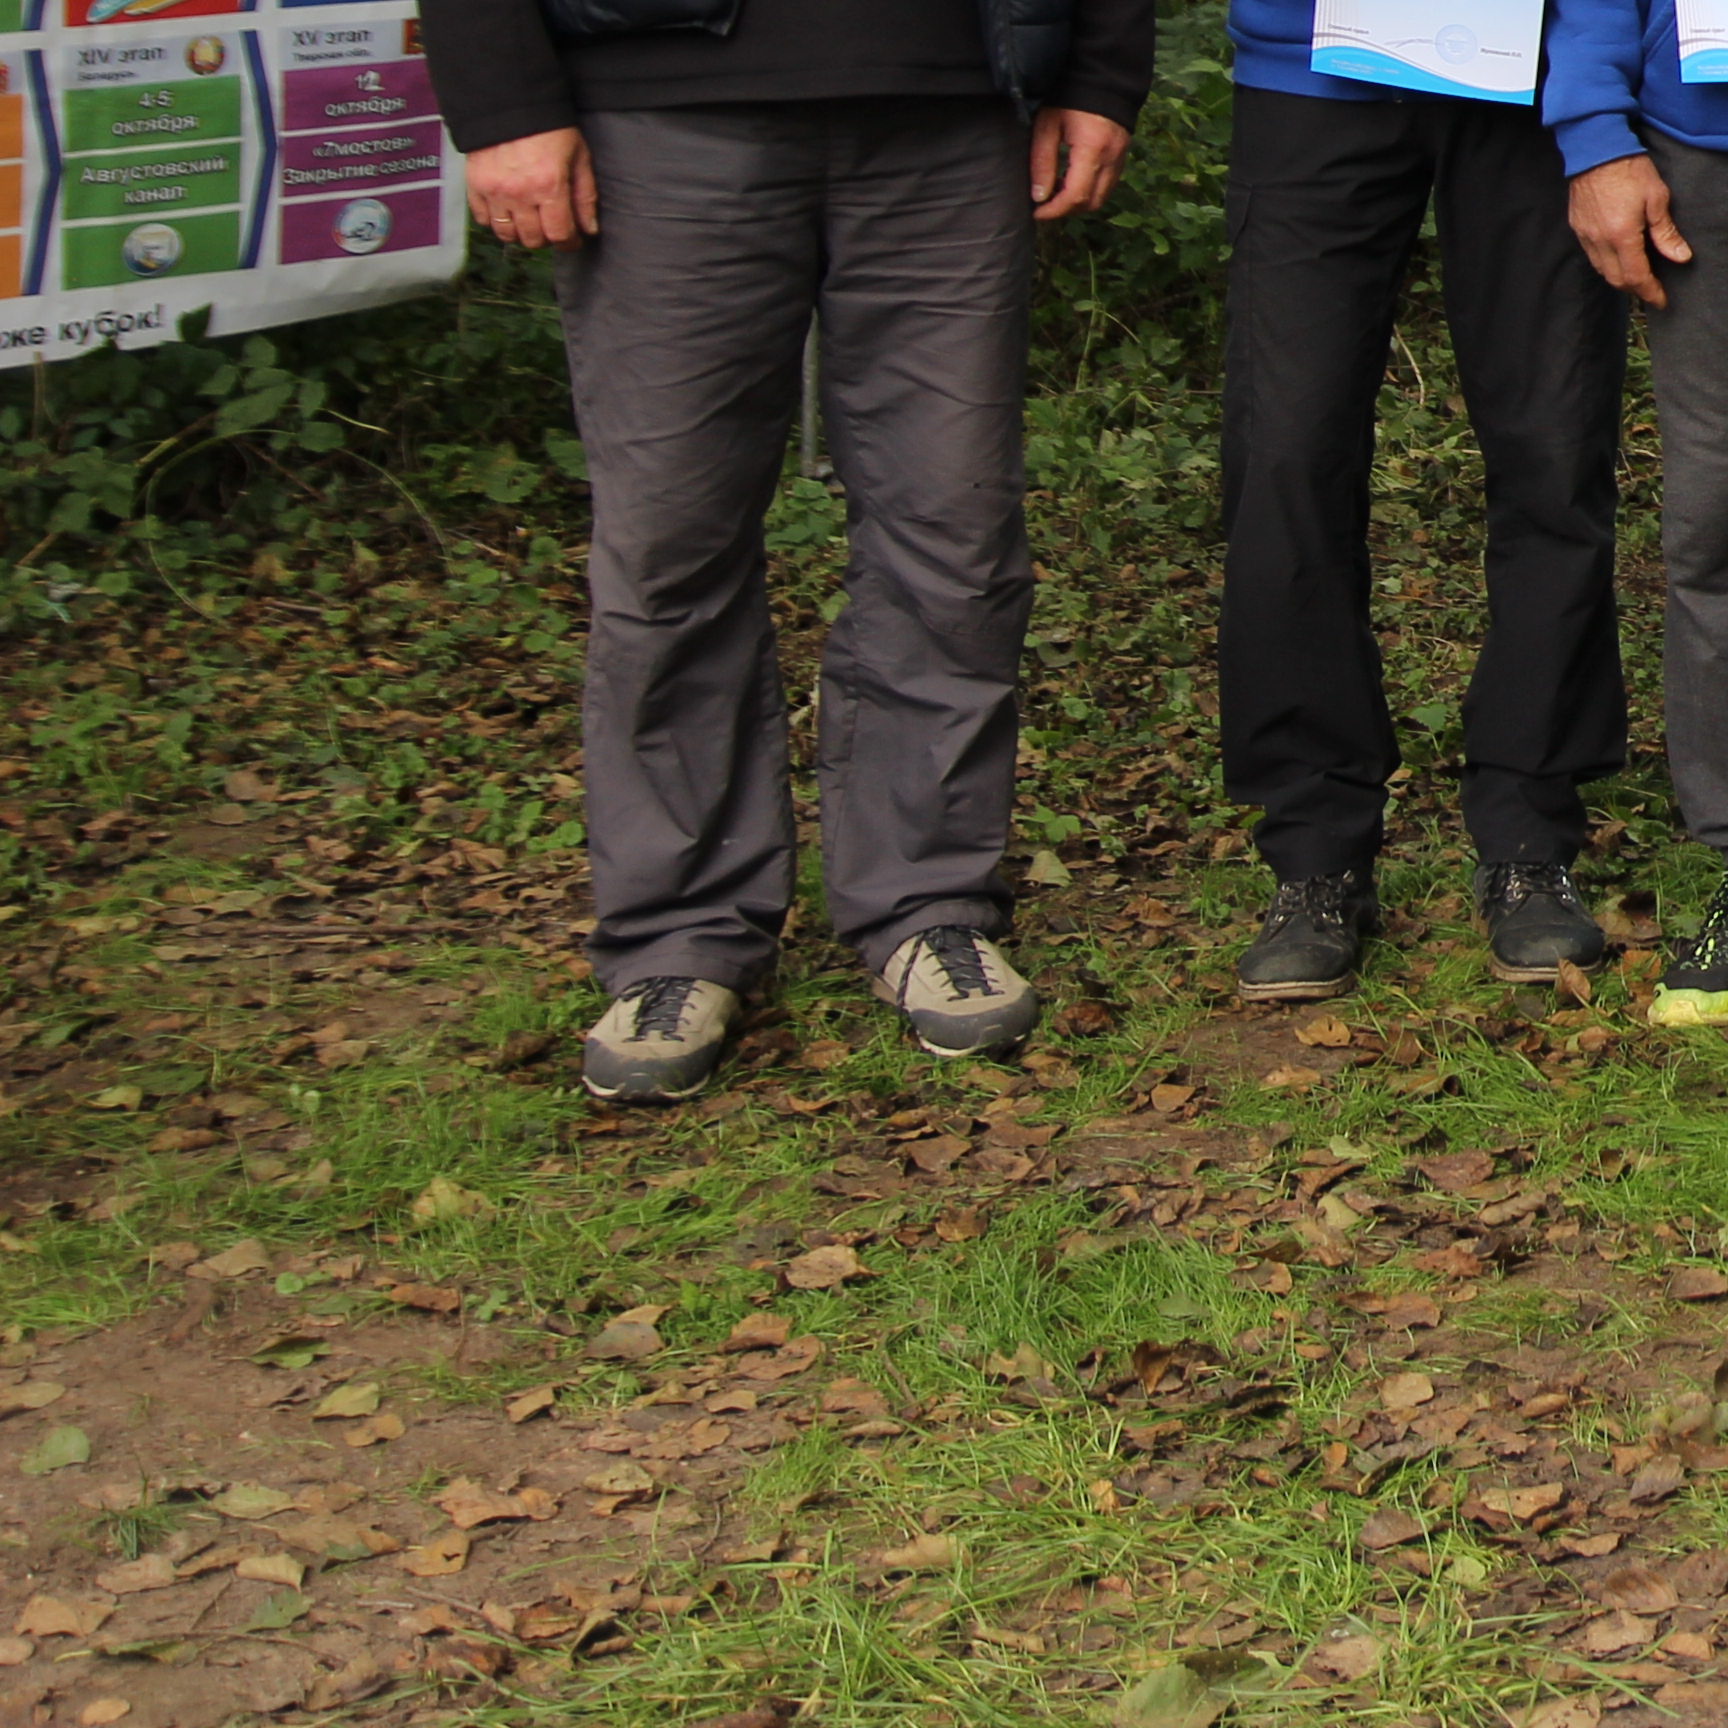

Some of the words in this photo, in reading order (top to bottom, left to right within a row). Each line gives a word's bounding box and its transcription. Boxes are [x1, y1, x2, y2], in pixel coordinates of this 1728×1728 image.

[325, 29, 371, 45] этап
[117, 46, 166, 64] этап
[324, 96, 407, 118] октября
[111, 114, 199, 136] октября
[80, 155, 229, 184] Августовский
[124, 184, 188, 206] канал
[58, 302, 166, 345] кубок!
